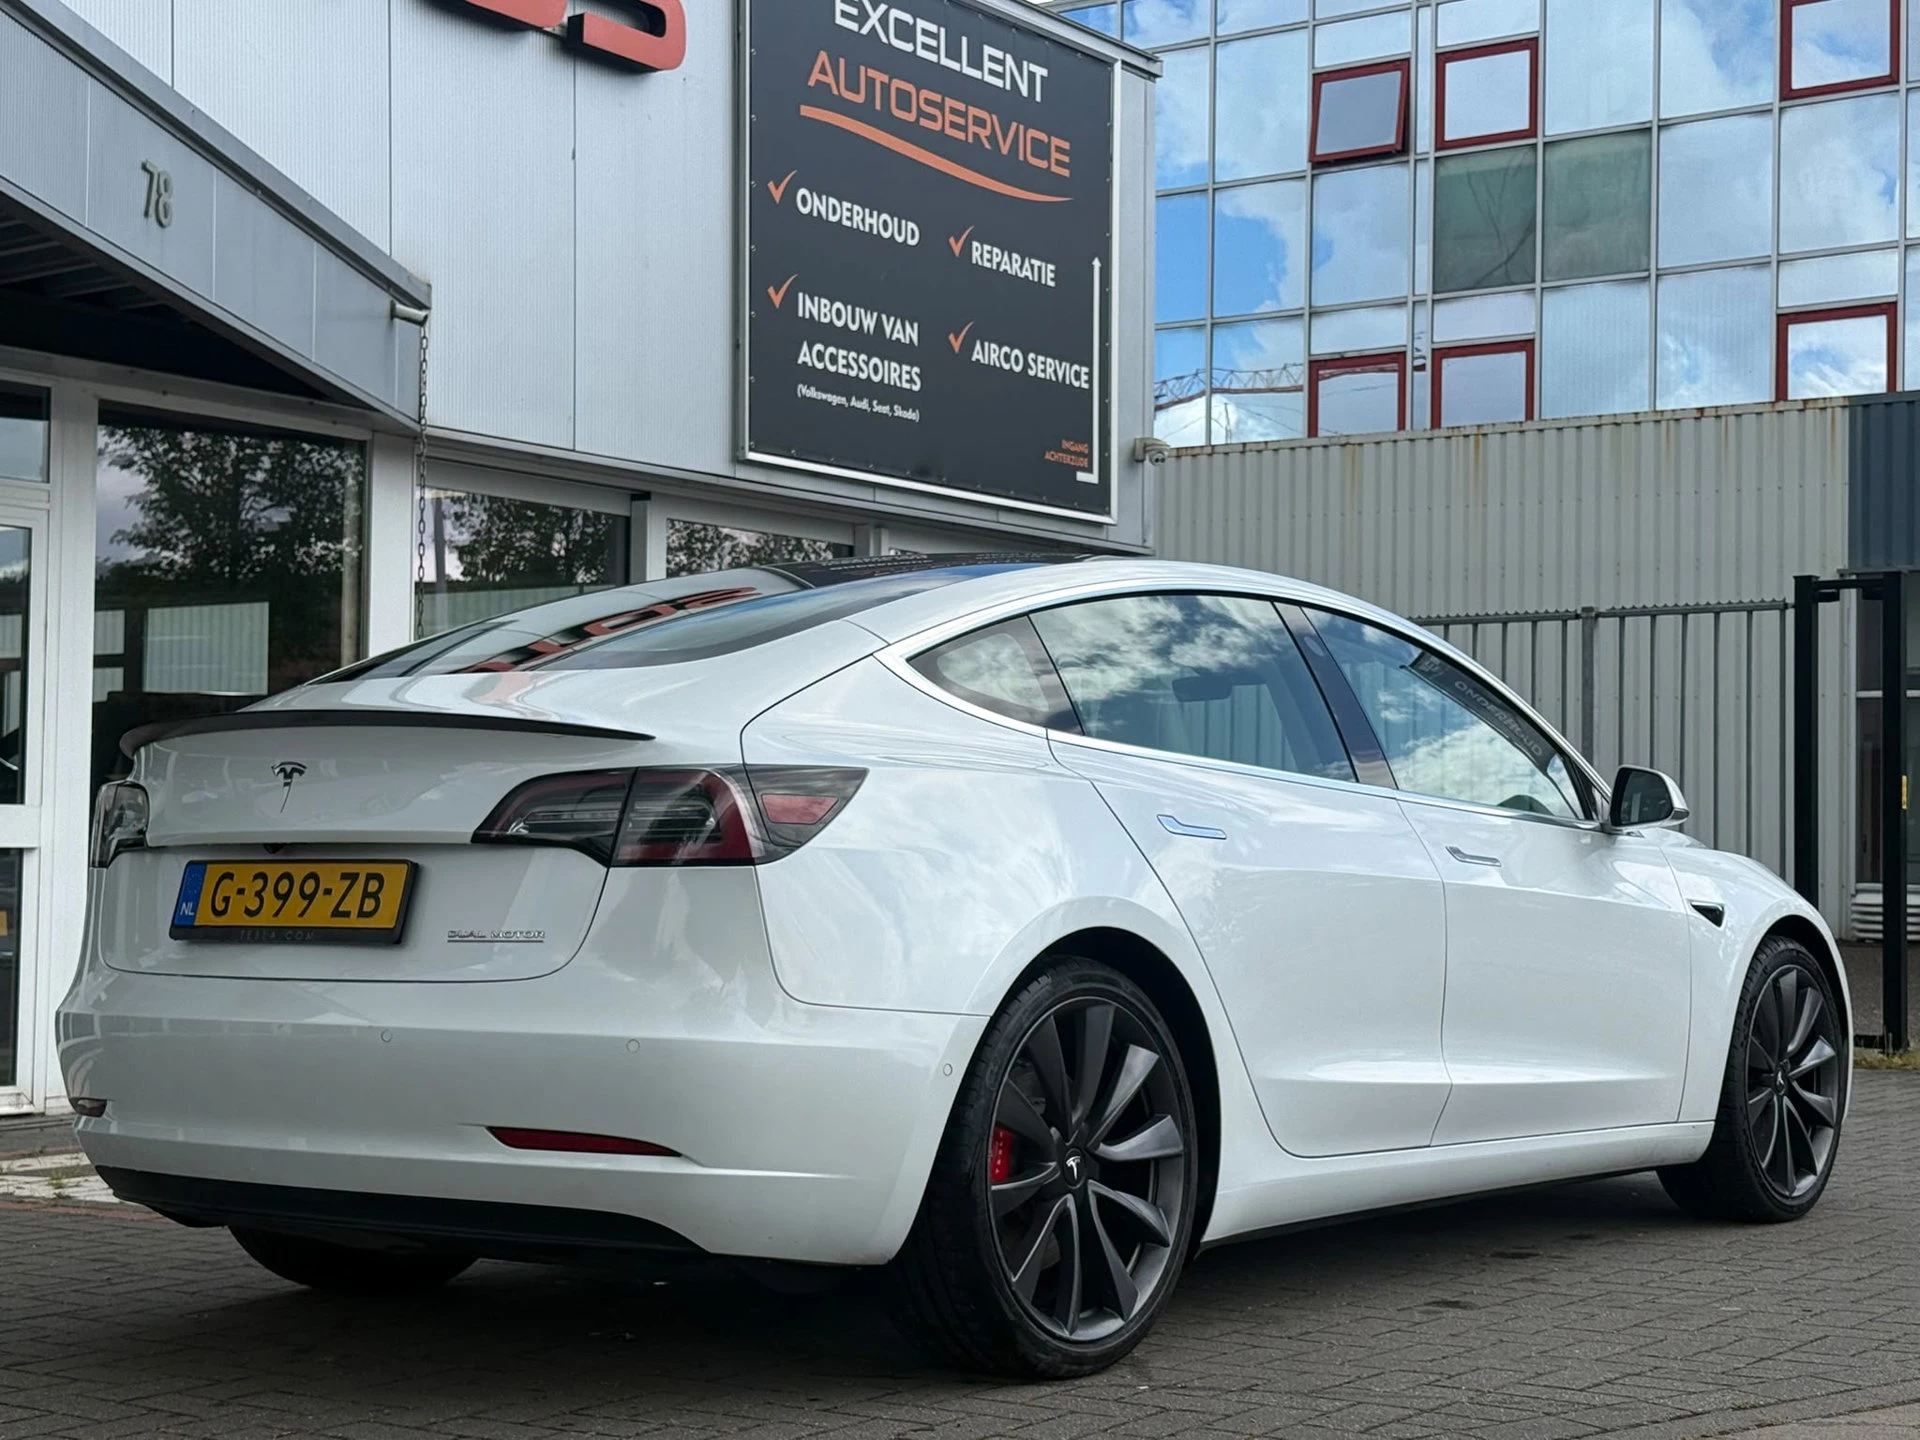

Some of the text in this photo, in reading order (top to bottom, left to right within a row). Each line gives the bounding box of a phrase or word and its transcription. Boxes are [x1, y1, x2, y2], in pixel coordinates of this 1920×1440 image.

[834, 0, 1048, 102] EXCELLENT
[808, 50, 1071, 178] AUTOSERVICE
[141, 159, 173, 229] 78
[796, 187, 920, 247] ONDERHOUD
[971, 241, 1056, 288] REPARATIE
[797, 292, 919, 347] INBOUW VAN
[797, 340, 921, 391] ACCESSOIRES
[971, 340, 1090, 390] AIRCO SERVICE
[850, 396, 871, 412] Audi,
[872, 400, 892, 416] Seat,
[180, 901, 195, 916] NL
[210, 871, 386, 919] G-399-ZB
[490, 930, 545, 939] MOTOR
